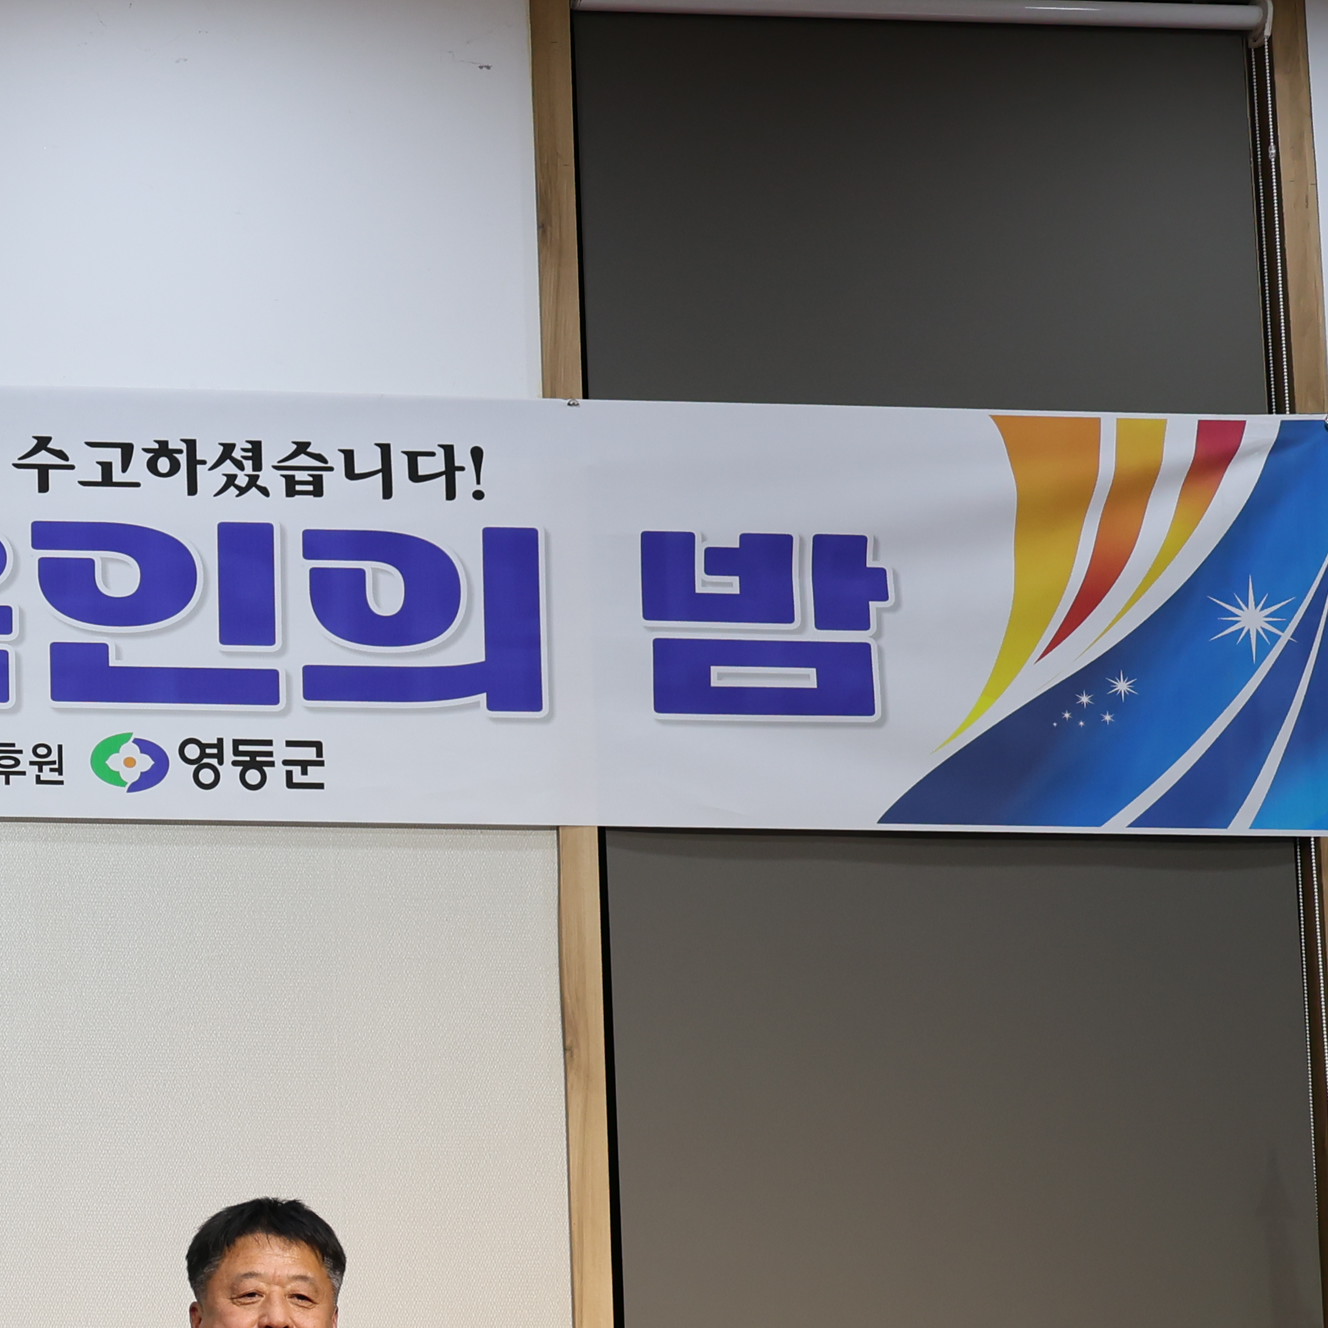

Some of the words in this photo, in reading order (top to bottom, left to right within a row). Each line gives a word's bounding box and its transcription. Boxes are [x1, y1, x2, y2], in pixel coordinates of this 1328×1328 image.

[12, 436, 485, 502] 수고하셨습니다!
[641, 531, 889, 717] 밤
[178, 737, 325, 793] 영동군
